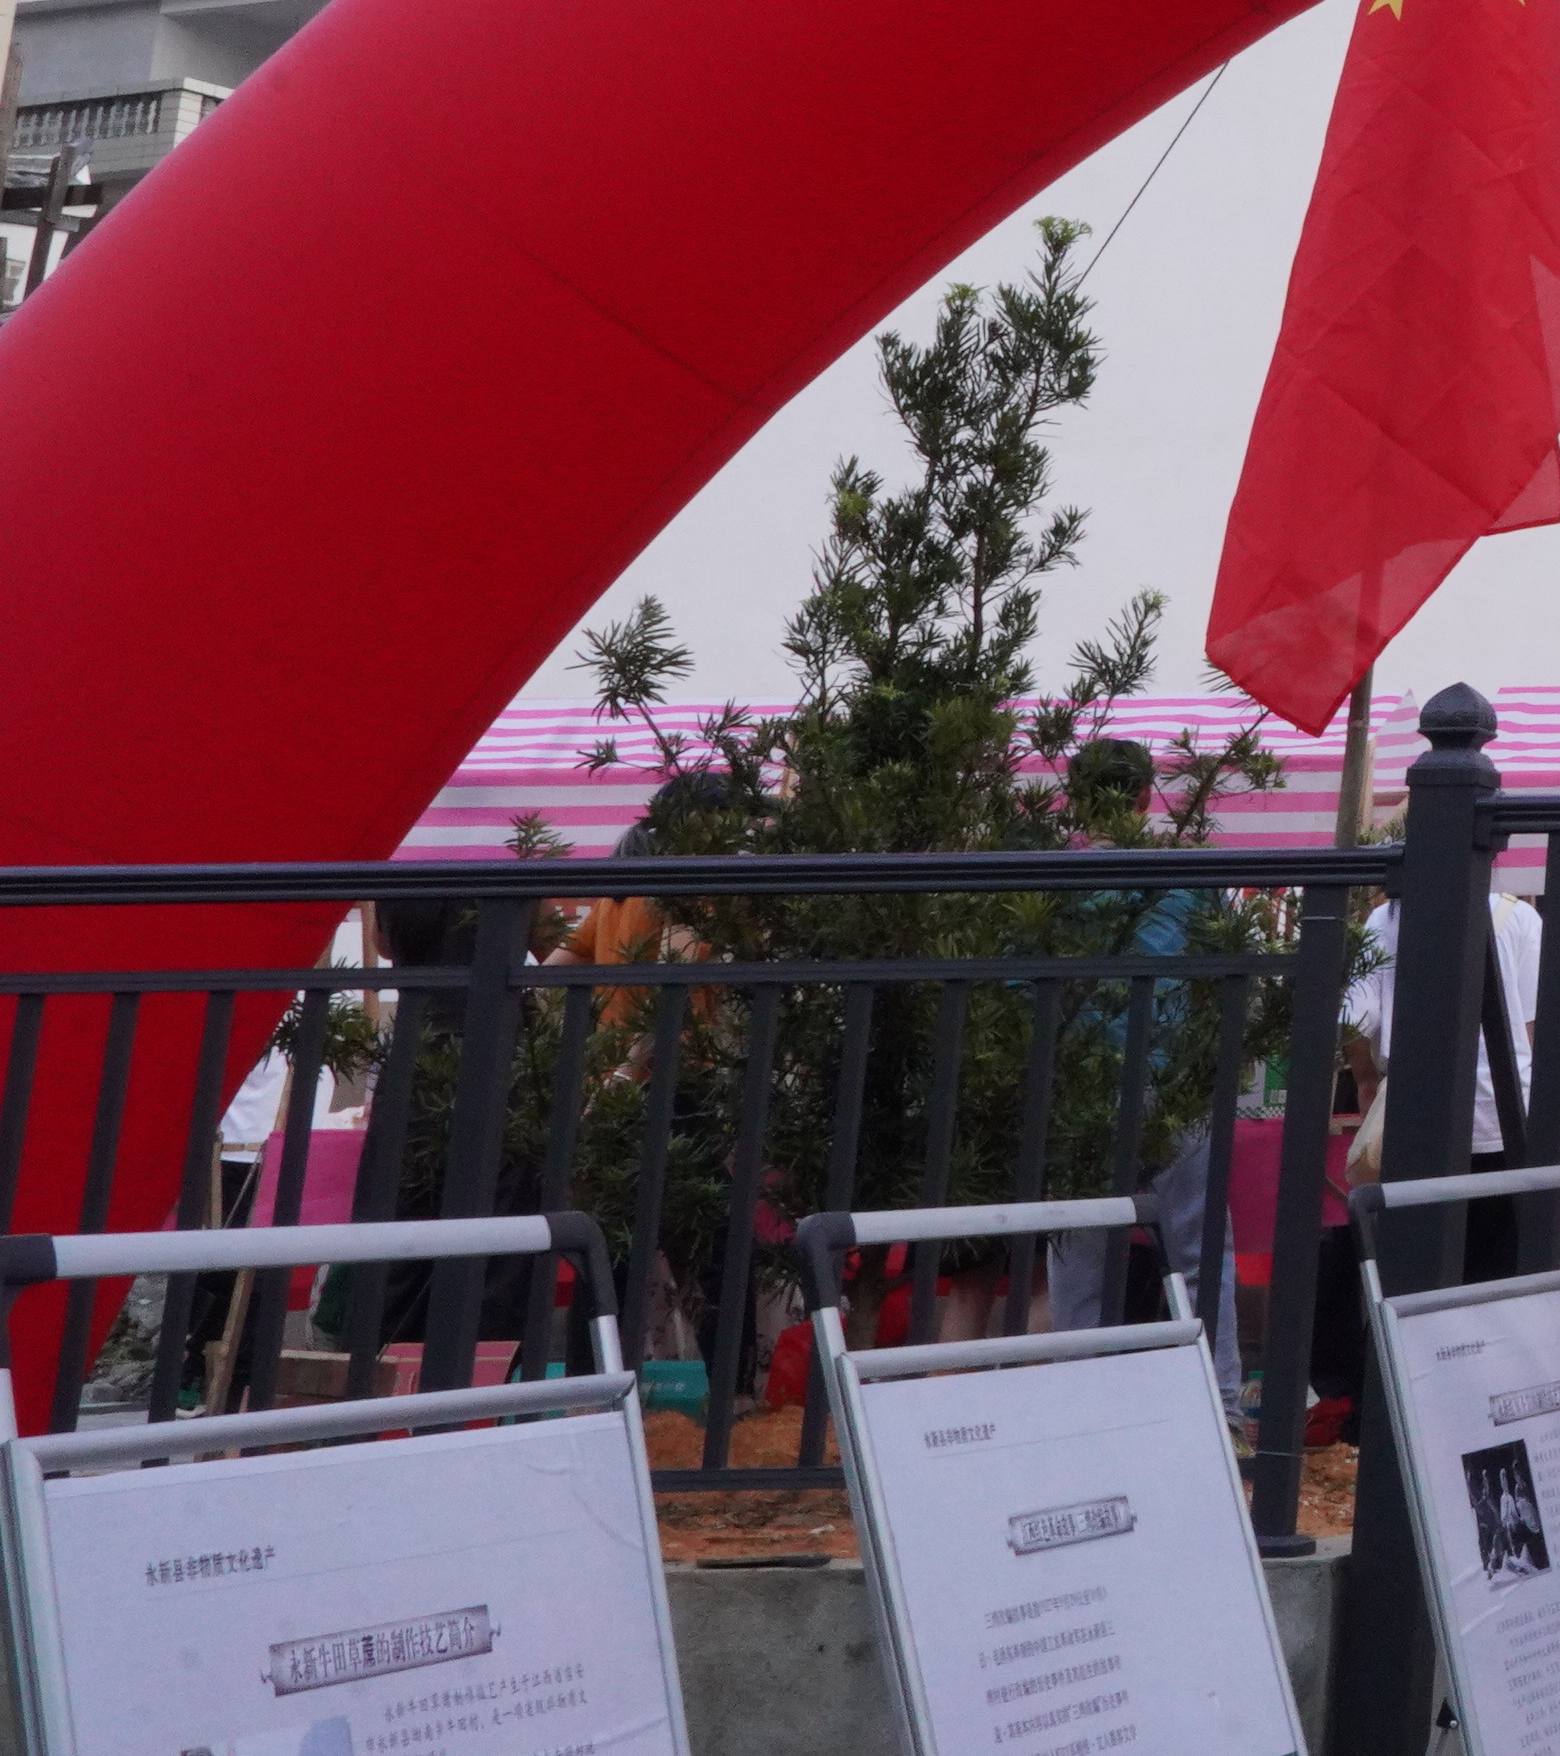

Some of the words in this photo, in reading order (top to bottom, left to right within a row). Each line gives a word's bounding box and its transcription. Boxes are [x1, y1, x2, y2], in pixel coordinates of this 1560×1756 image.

[143, 1545, 276, 1587] 永新县非物质文化遗产
